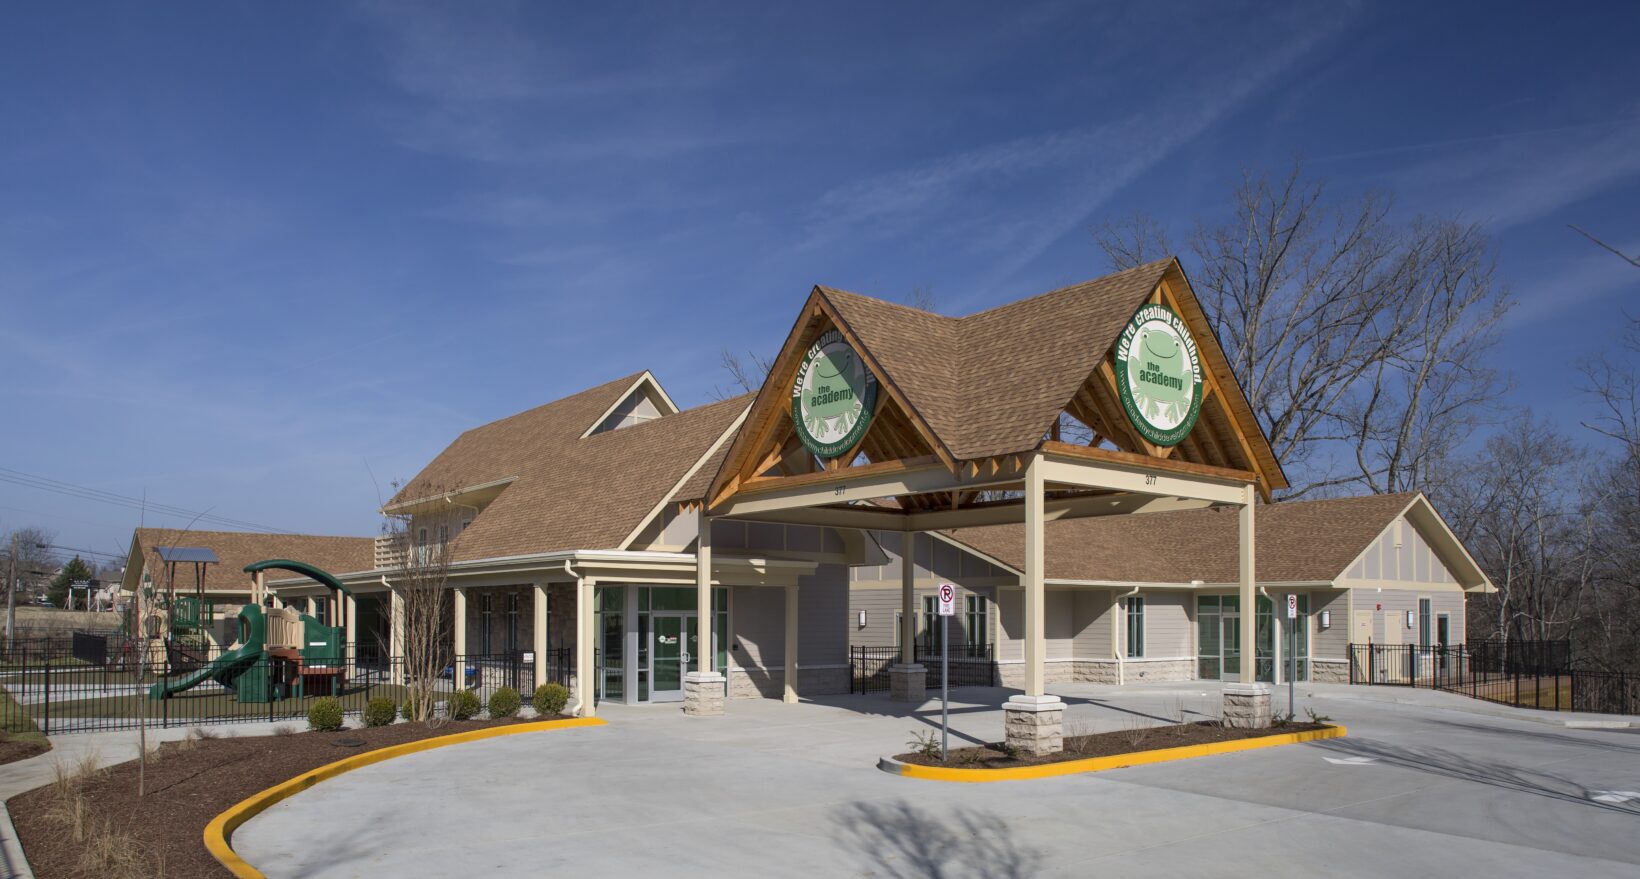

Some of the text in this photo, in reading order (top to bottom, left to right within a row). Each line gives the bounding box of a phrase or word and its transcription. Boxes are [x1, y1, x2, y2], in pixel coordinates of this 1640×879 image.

[1118, 323, 1136, 362] We're
[1135, 305, 1172, 325] creating
[1147, 362, 1160, 372] the
[793, 361, 809, 398] We're
[1139, 370, 1183, 391] academy
[811, 387, 854, 407] academy
[818, 385, 831, 394] the
[1145, 473, 1156, 486] 377
[834, 485, 846, 496] 377
